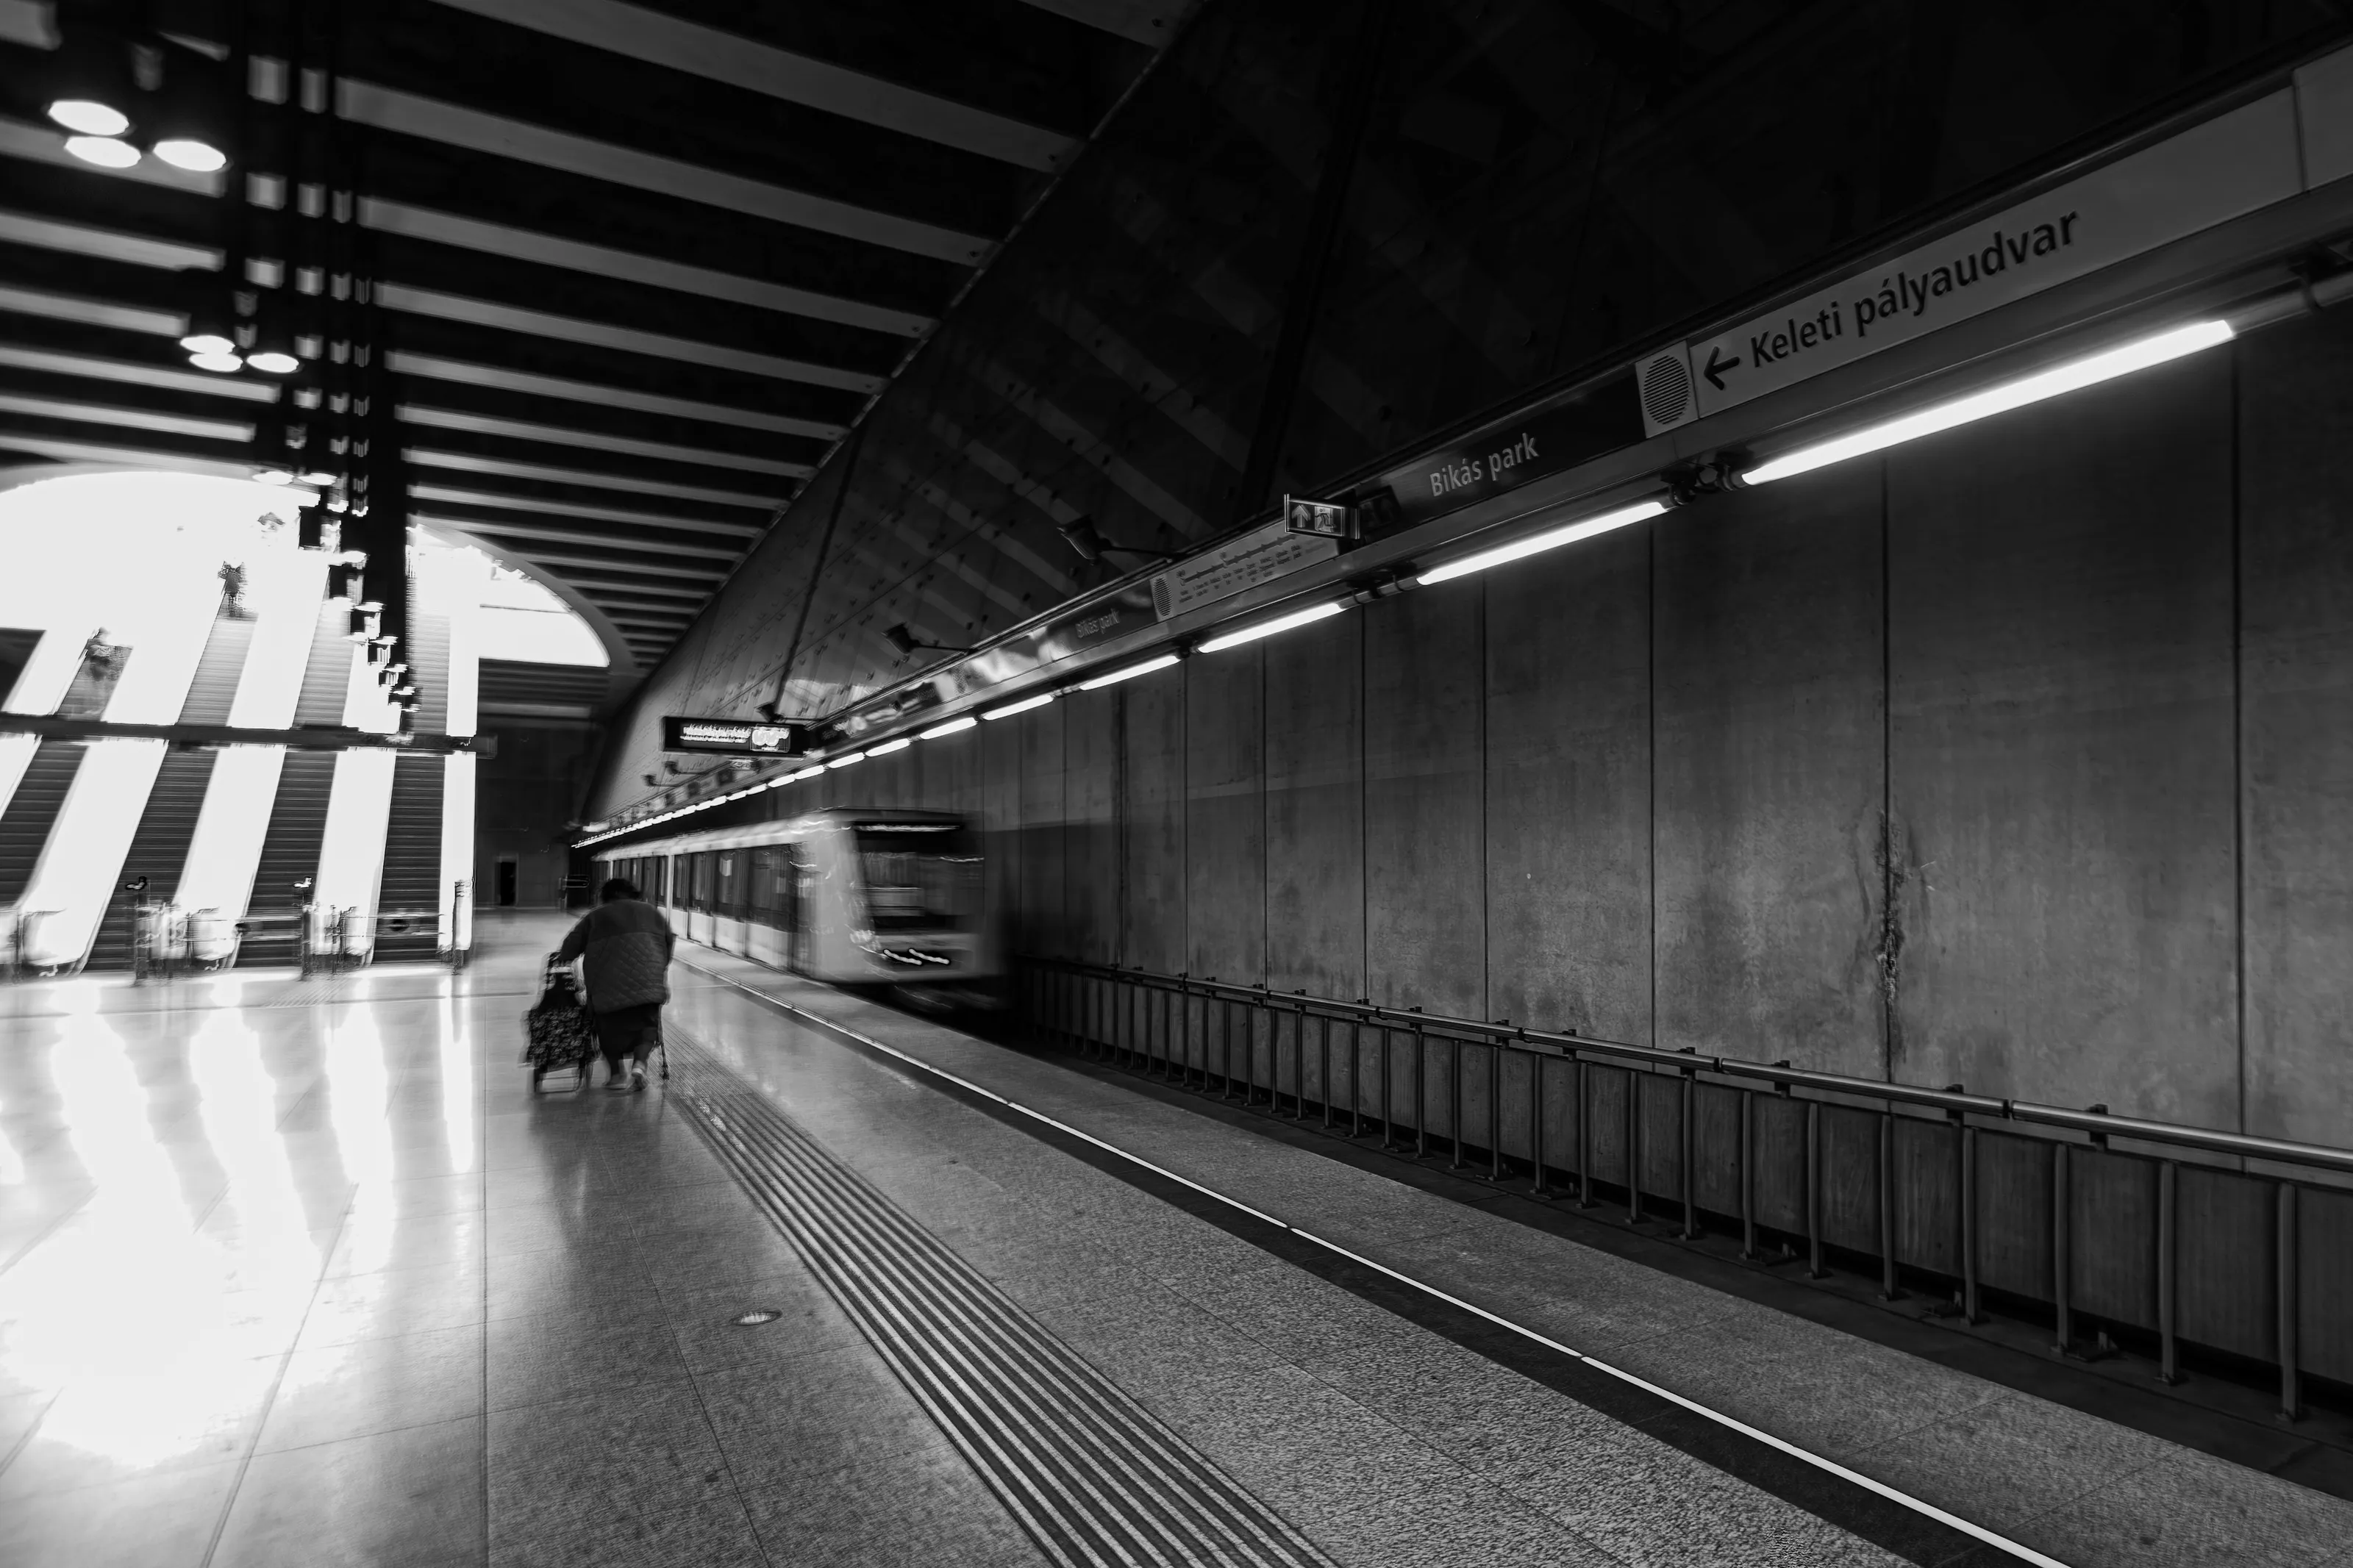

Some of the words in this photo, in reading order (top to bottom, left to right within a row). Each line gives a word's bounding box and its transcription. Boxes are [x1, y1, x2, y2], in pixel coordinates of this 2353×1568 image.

[1751, 301, 1842, 368] Keleti
[1854, 210, 2077, 337] pályaudvar
[1429, 457, 1482, 497] Bikás
[1488, 432, 1540, 482] park
